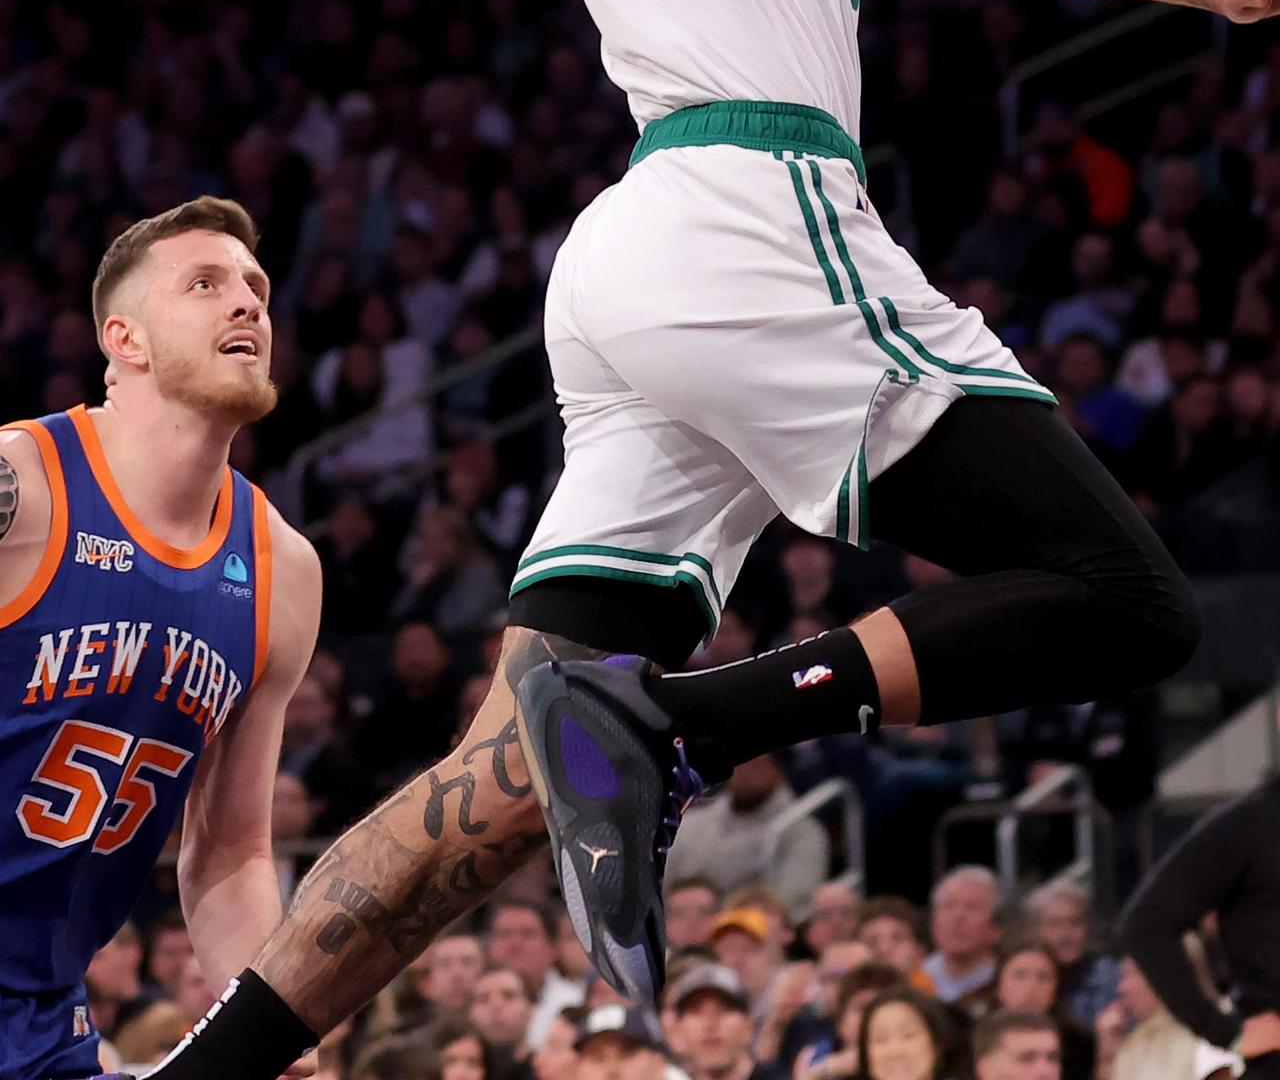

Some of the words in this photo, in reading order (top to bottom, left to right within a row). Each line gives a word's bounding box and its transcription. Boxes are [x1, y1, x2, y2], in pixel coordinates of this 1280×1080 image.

[75, 531, 134, 572] NYC
[23, 621, 152, 698] NEW
[158, 626, 243, 741] YORK
[17, 719, 195, 855] 55
